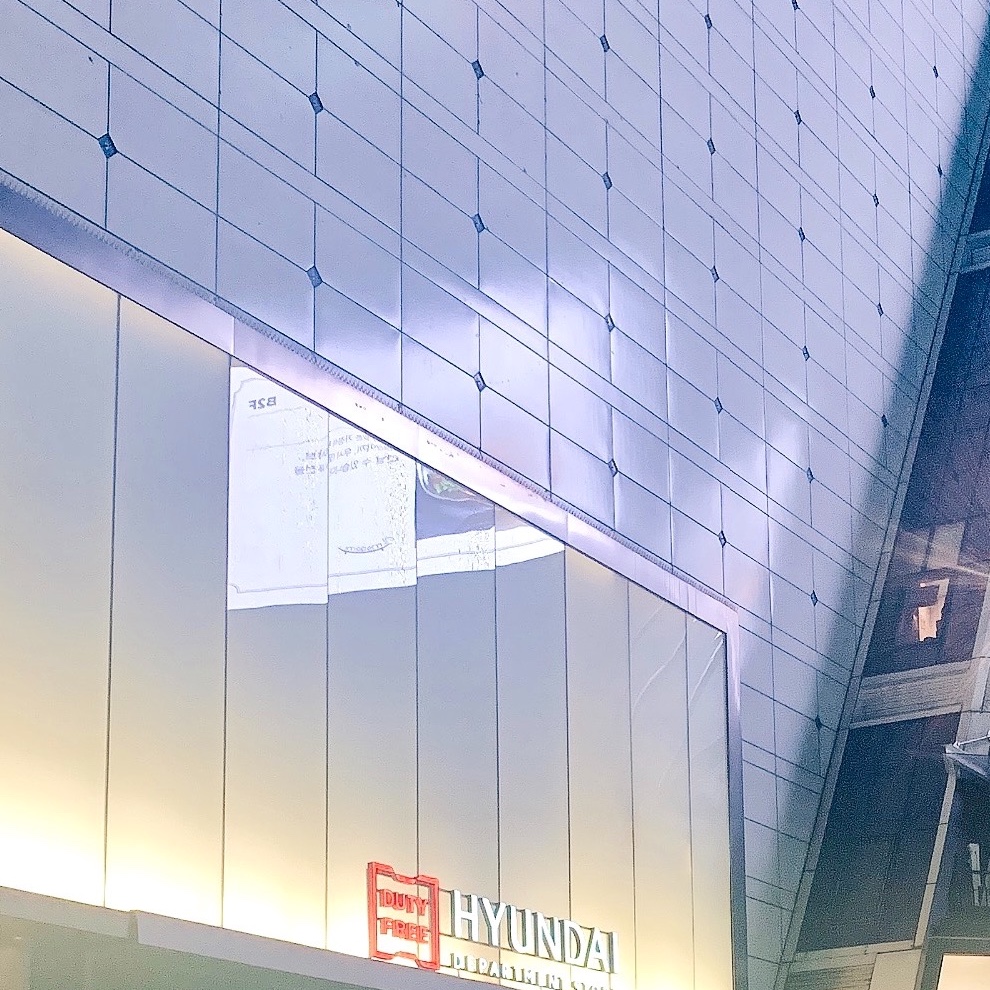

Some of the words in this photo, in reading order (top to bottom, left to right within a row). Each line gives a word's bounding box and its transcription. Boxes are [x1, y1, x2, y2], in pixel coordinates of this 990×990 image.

[380, 889, 429, 916] DUTY
[380, 917, 428, 944] FREE
[450, 889, 619, 974] HYUNDAI
